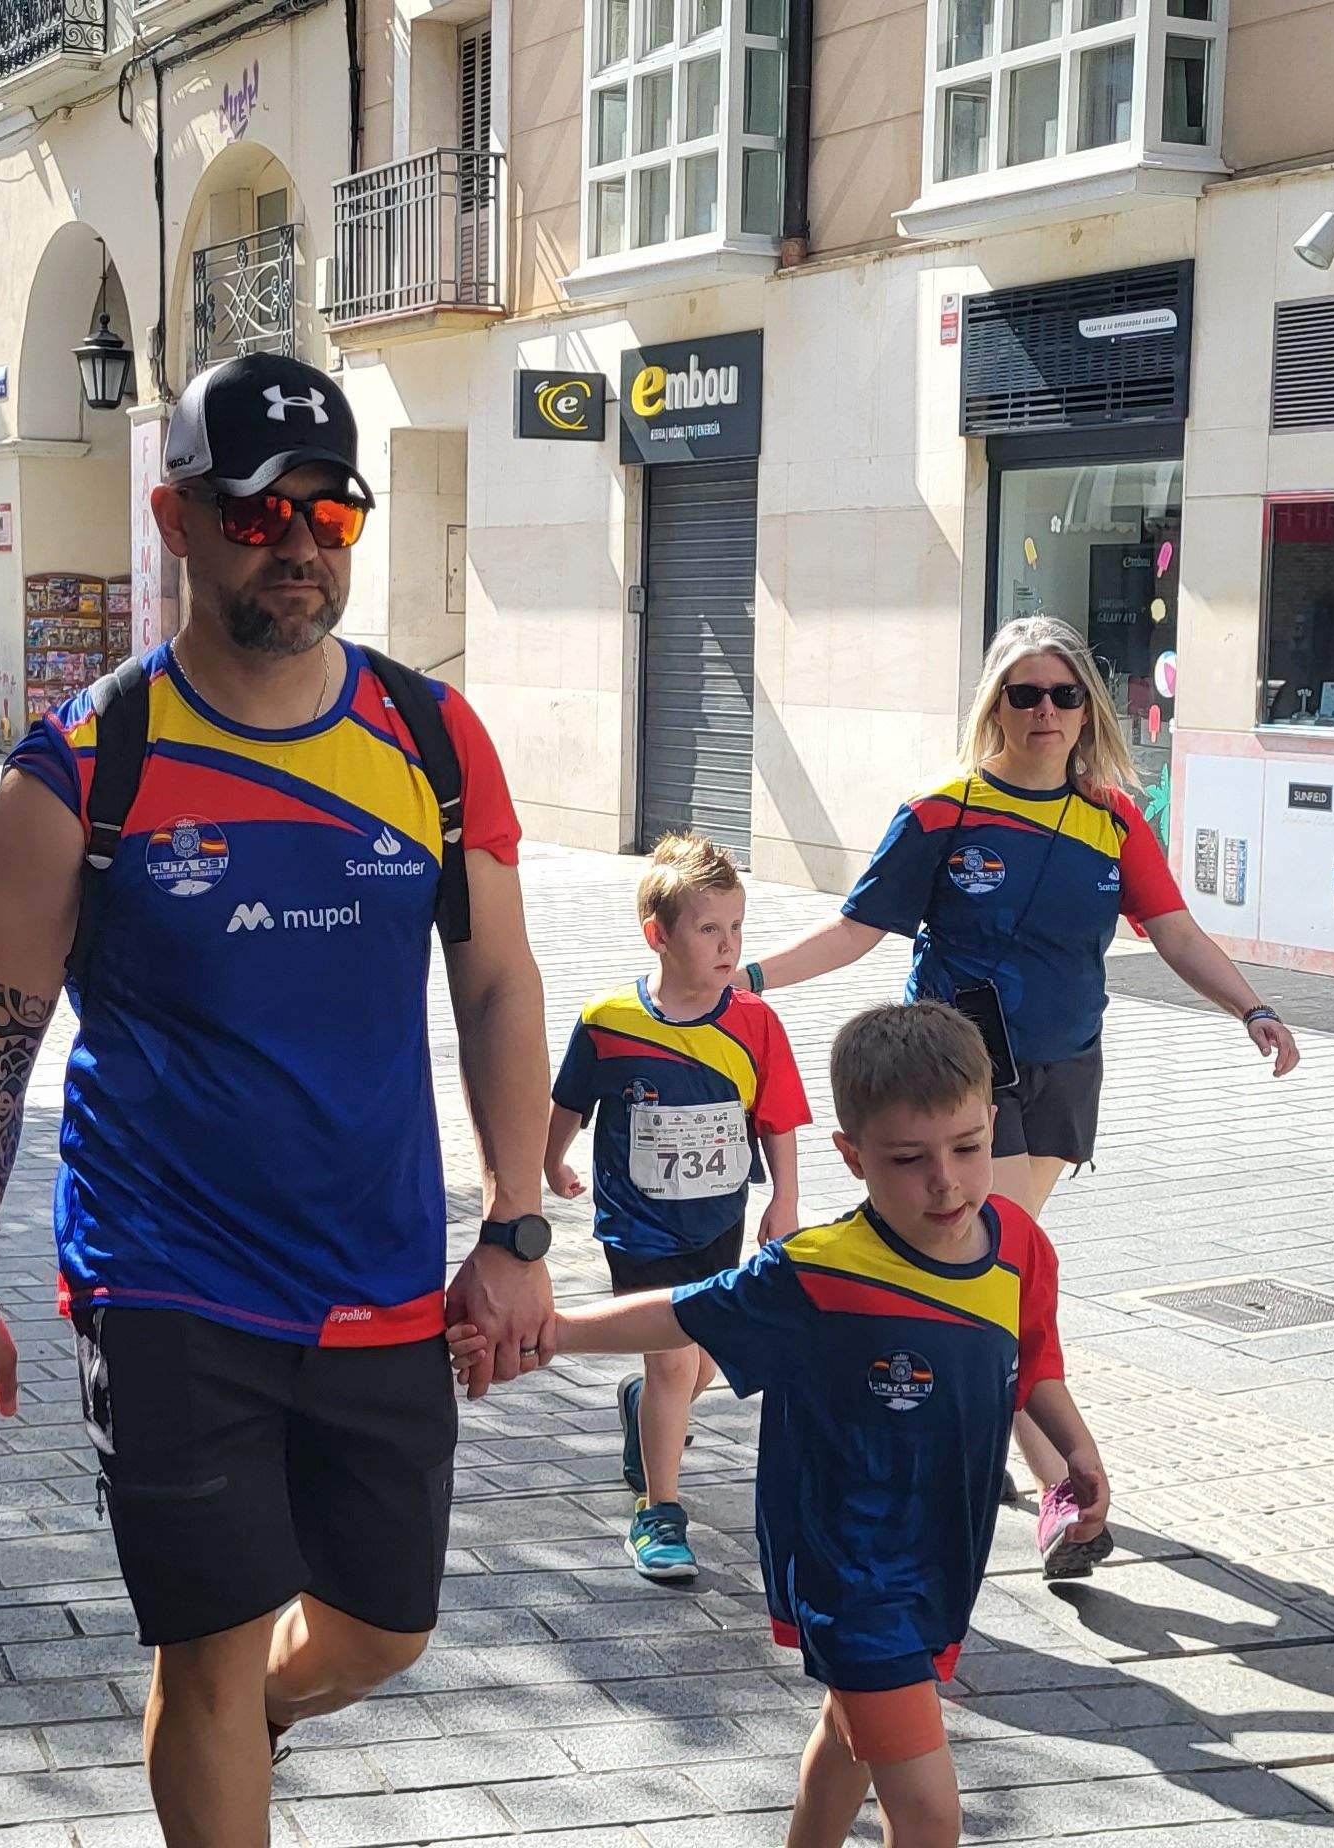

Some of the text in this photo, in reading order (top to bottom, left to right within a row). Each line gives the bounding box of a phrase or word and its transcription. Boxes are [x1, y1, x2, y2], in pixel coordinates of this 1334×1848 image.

[631, 354, 739, 417] embou
[1293, 790, 1328, 803] SUNFIELD
[149, 857, 227, 875] RUTA 091
[345, 859, 426, 877] Santander
[283, 901, 362, 932] mupol
[657, 1149, 727, 1180] 734
